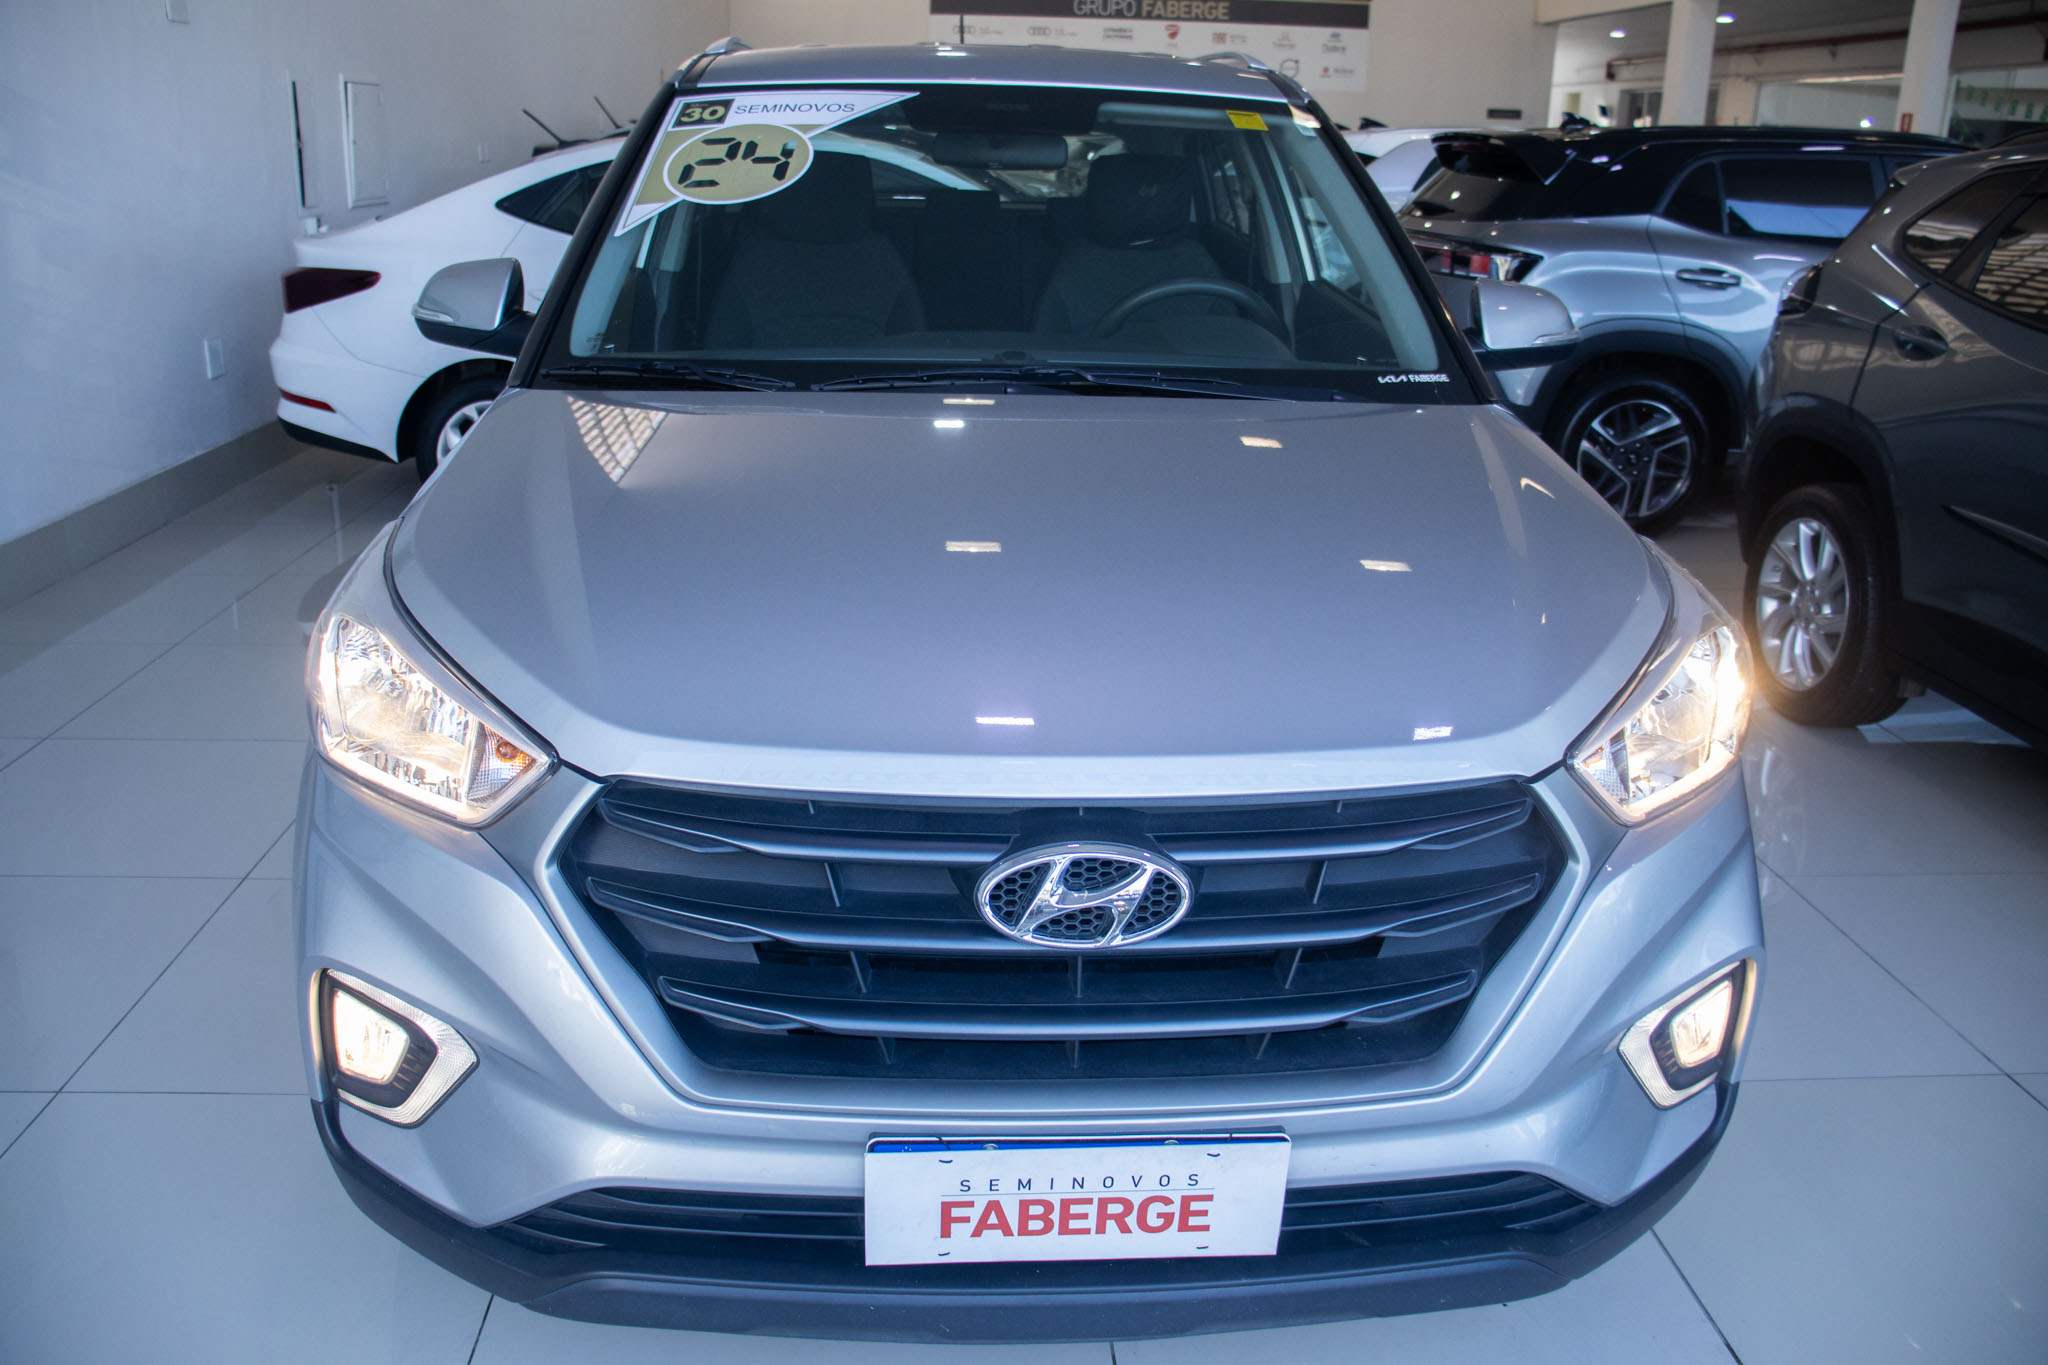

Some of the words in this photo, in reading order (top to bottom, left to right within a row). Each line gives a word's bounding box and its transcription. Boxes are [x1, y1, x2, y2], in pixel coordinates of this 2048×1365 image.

[1073, 0, 1136, 17] GRUPO
[1141, 0, 1230, 19] FABERGE
[680, 105, 725, 122] 30
[735, 103, 855, 114] SEMINOVOS
[677, 136, 798, 189] 24
[1408, 373, 1450, 383] FABERGE
[960, 1174, 1199, 1192] SEMINOVOS
[940, 1194, 1214, 1238] FABERGE
